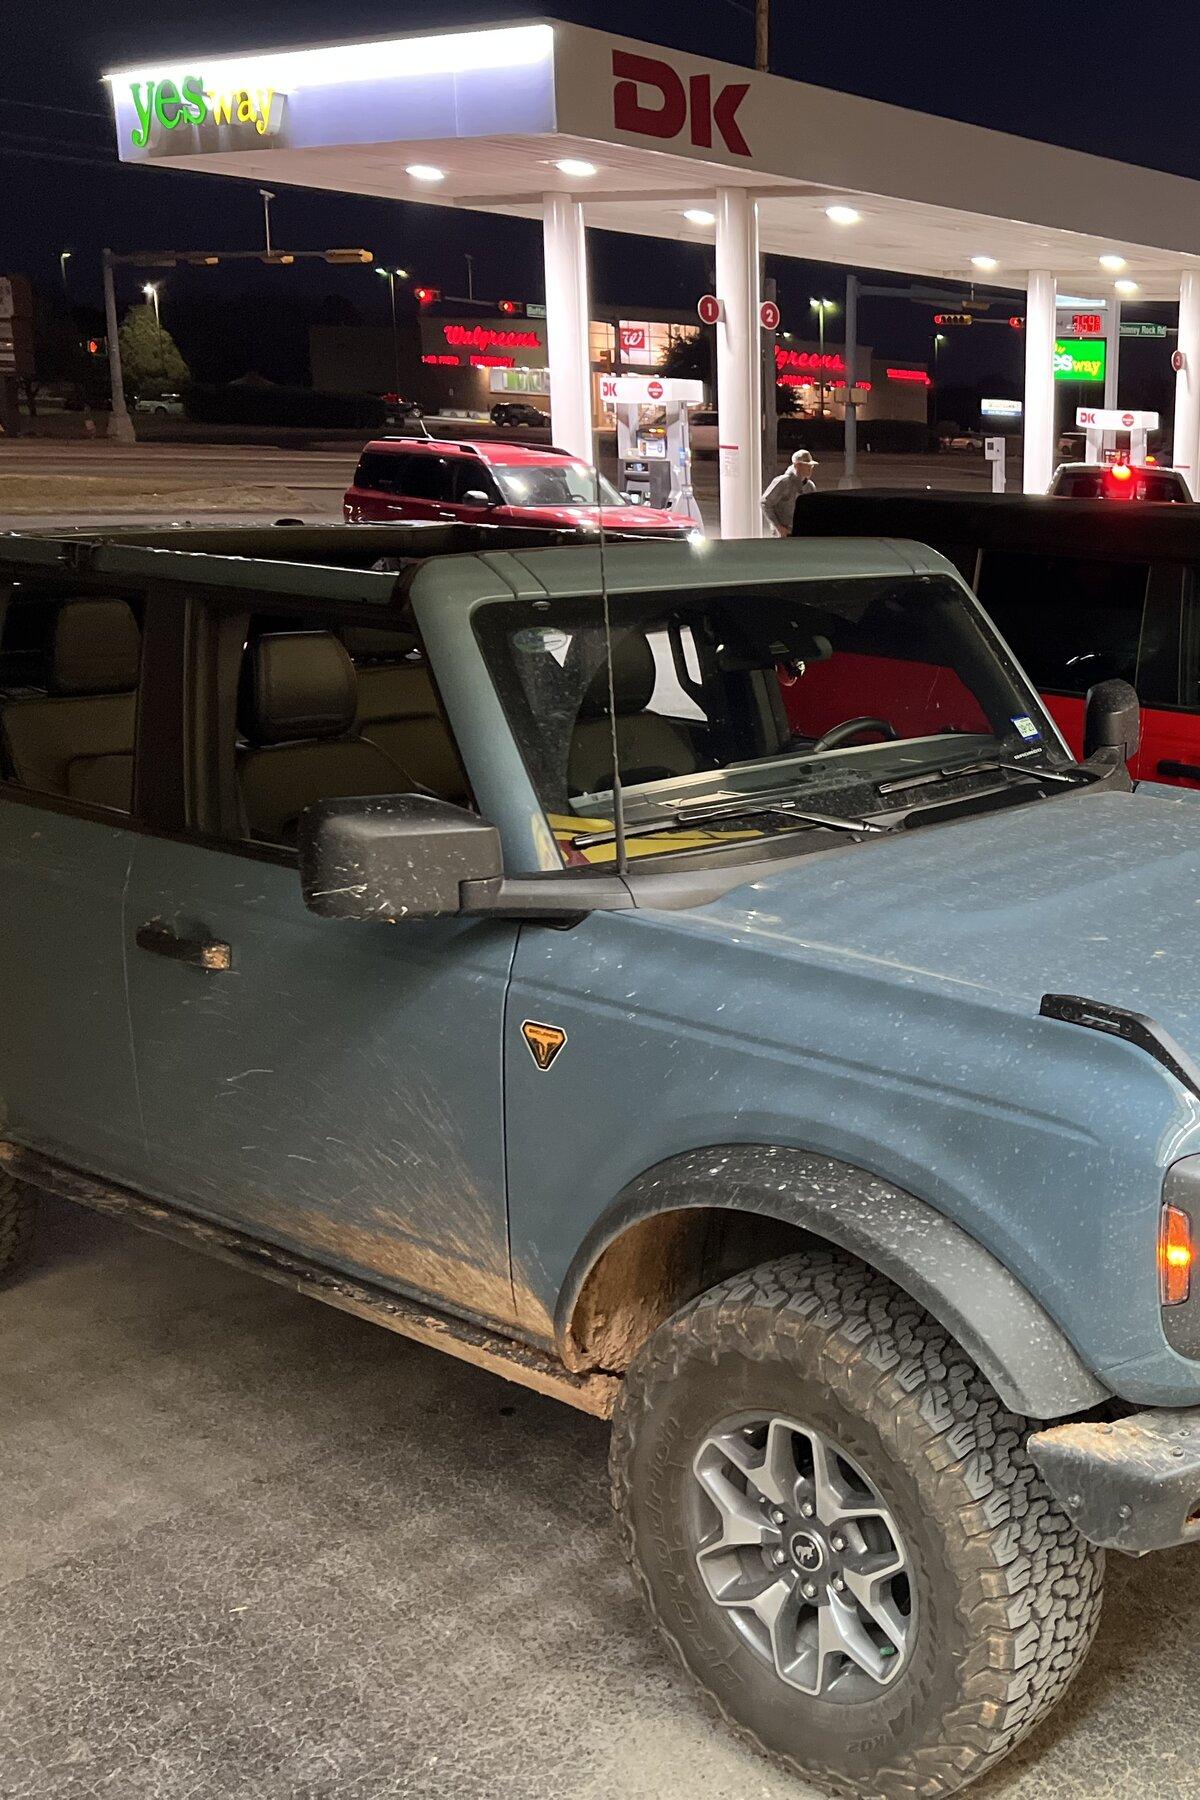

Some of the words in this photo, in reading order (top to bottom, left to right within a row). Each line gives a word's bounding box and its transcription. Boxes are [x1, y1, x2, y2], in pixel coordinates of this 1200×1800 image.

[611, 49, 753, 157] DK
[1141, 325, 1156, 335] Rock
[1157, 326, 1167, 335] Rd
[443, 326, 541, 351] Walgreens
[603, 382, 617, 397] DK
[1080, 412, 1096, 424] DK
